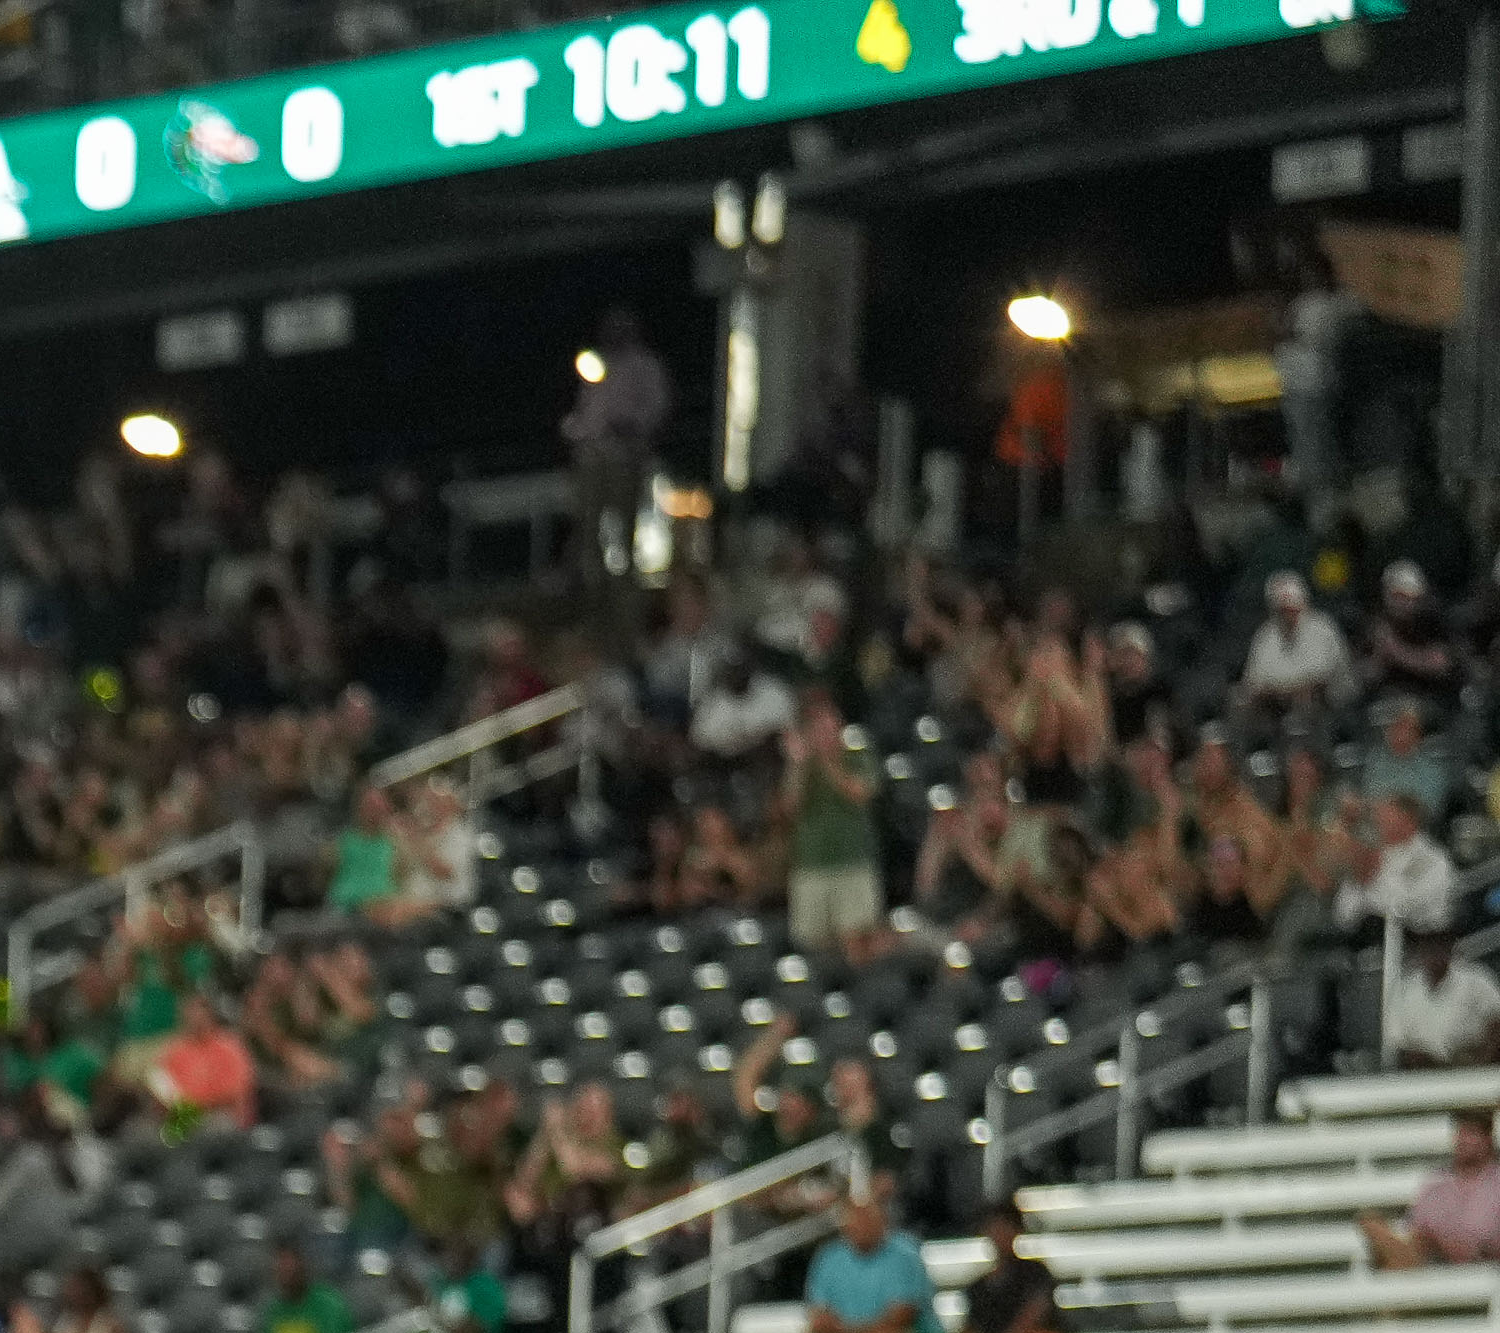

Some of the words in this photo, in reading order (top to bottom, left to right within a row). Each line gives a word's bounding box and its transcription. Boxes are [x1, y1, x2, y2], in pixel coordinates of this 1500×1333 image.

[75, 116, 137, 210] 0
[282, 87, 344, 181] 0
[426, 57, 539, 147] 1ST
[564, 6, 771, 127] 10:11
